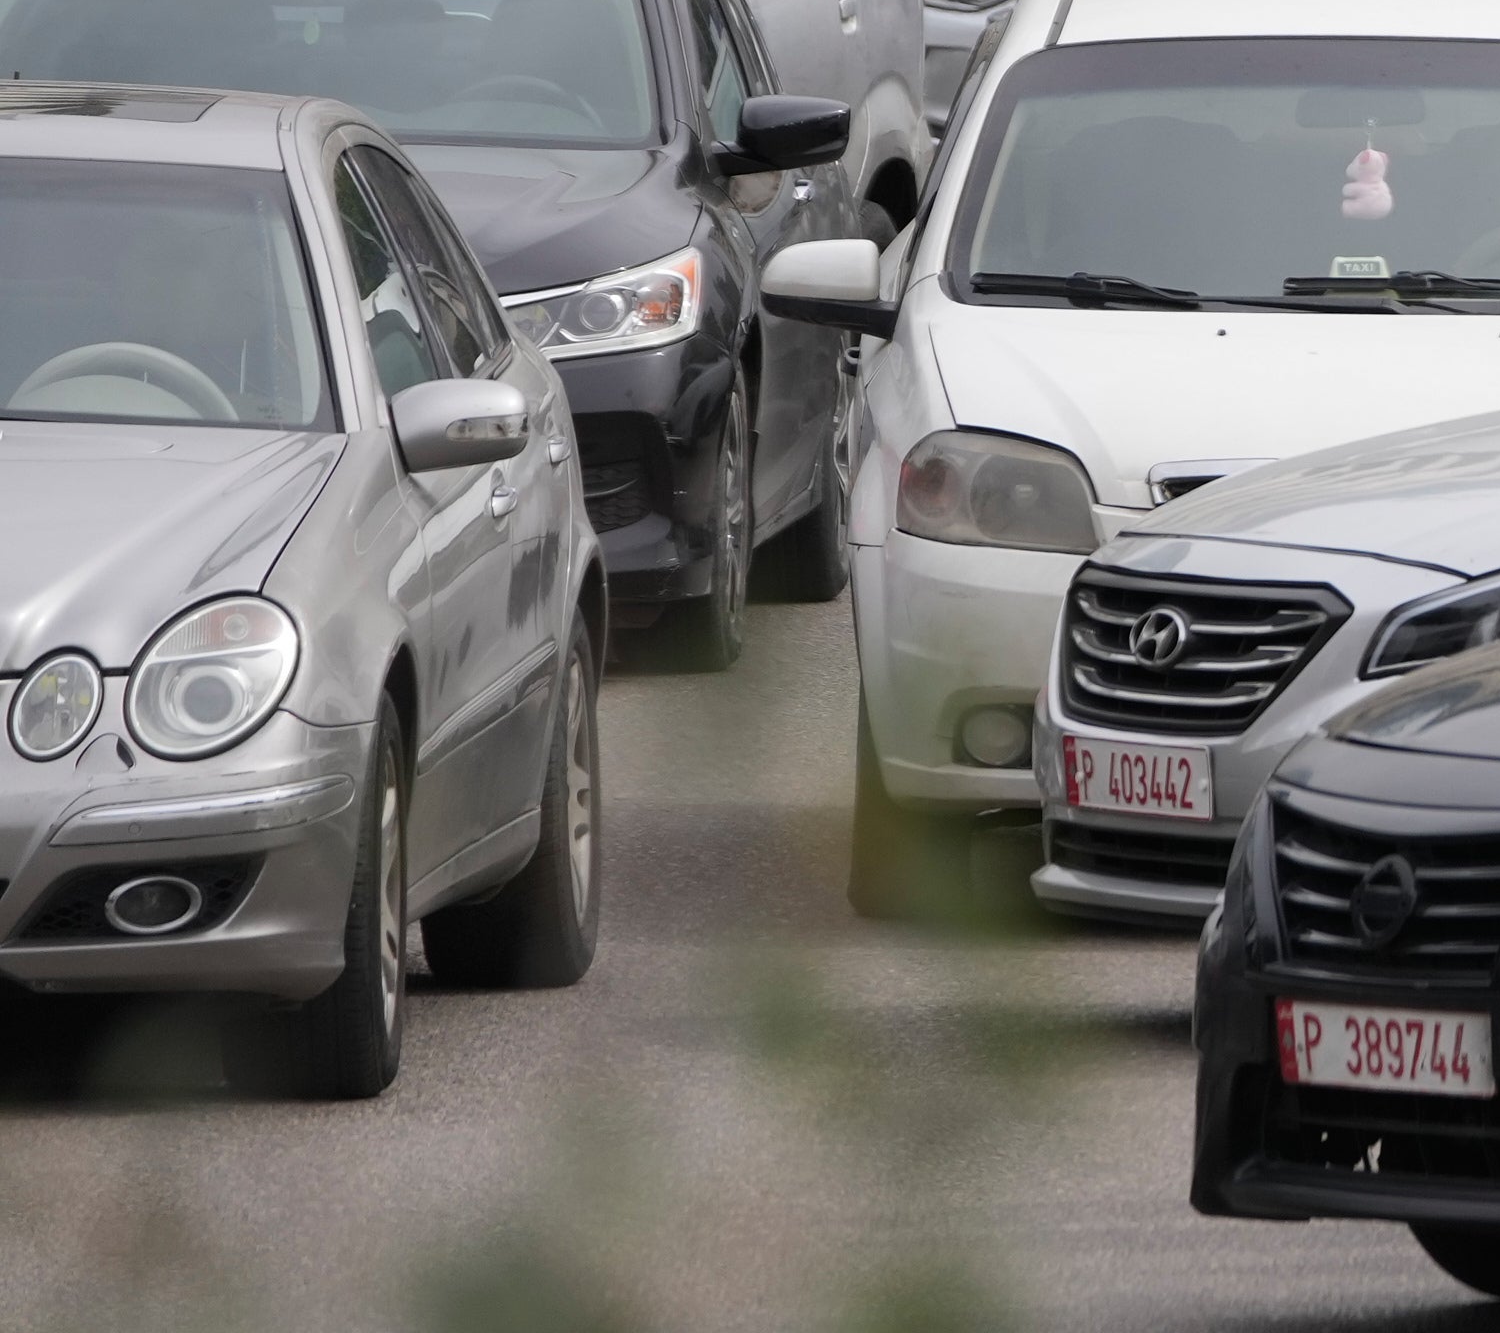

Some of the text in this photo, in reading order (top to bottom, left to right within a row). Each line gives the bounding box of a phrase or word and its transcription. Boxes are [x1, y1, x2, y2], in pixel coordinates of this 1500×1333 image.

[1343, 263, 1375, 272] TAXI
[1081, 749, 1193, 809] P 403442
[1303, 1012, 1470, 1083] P 389744
